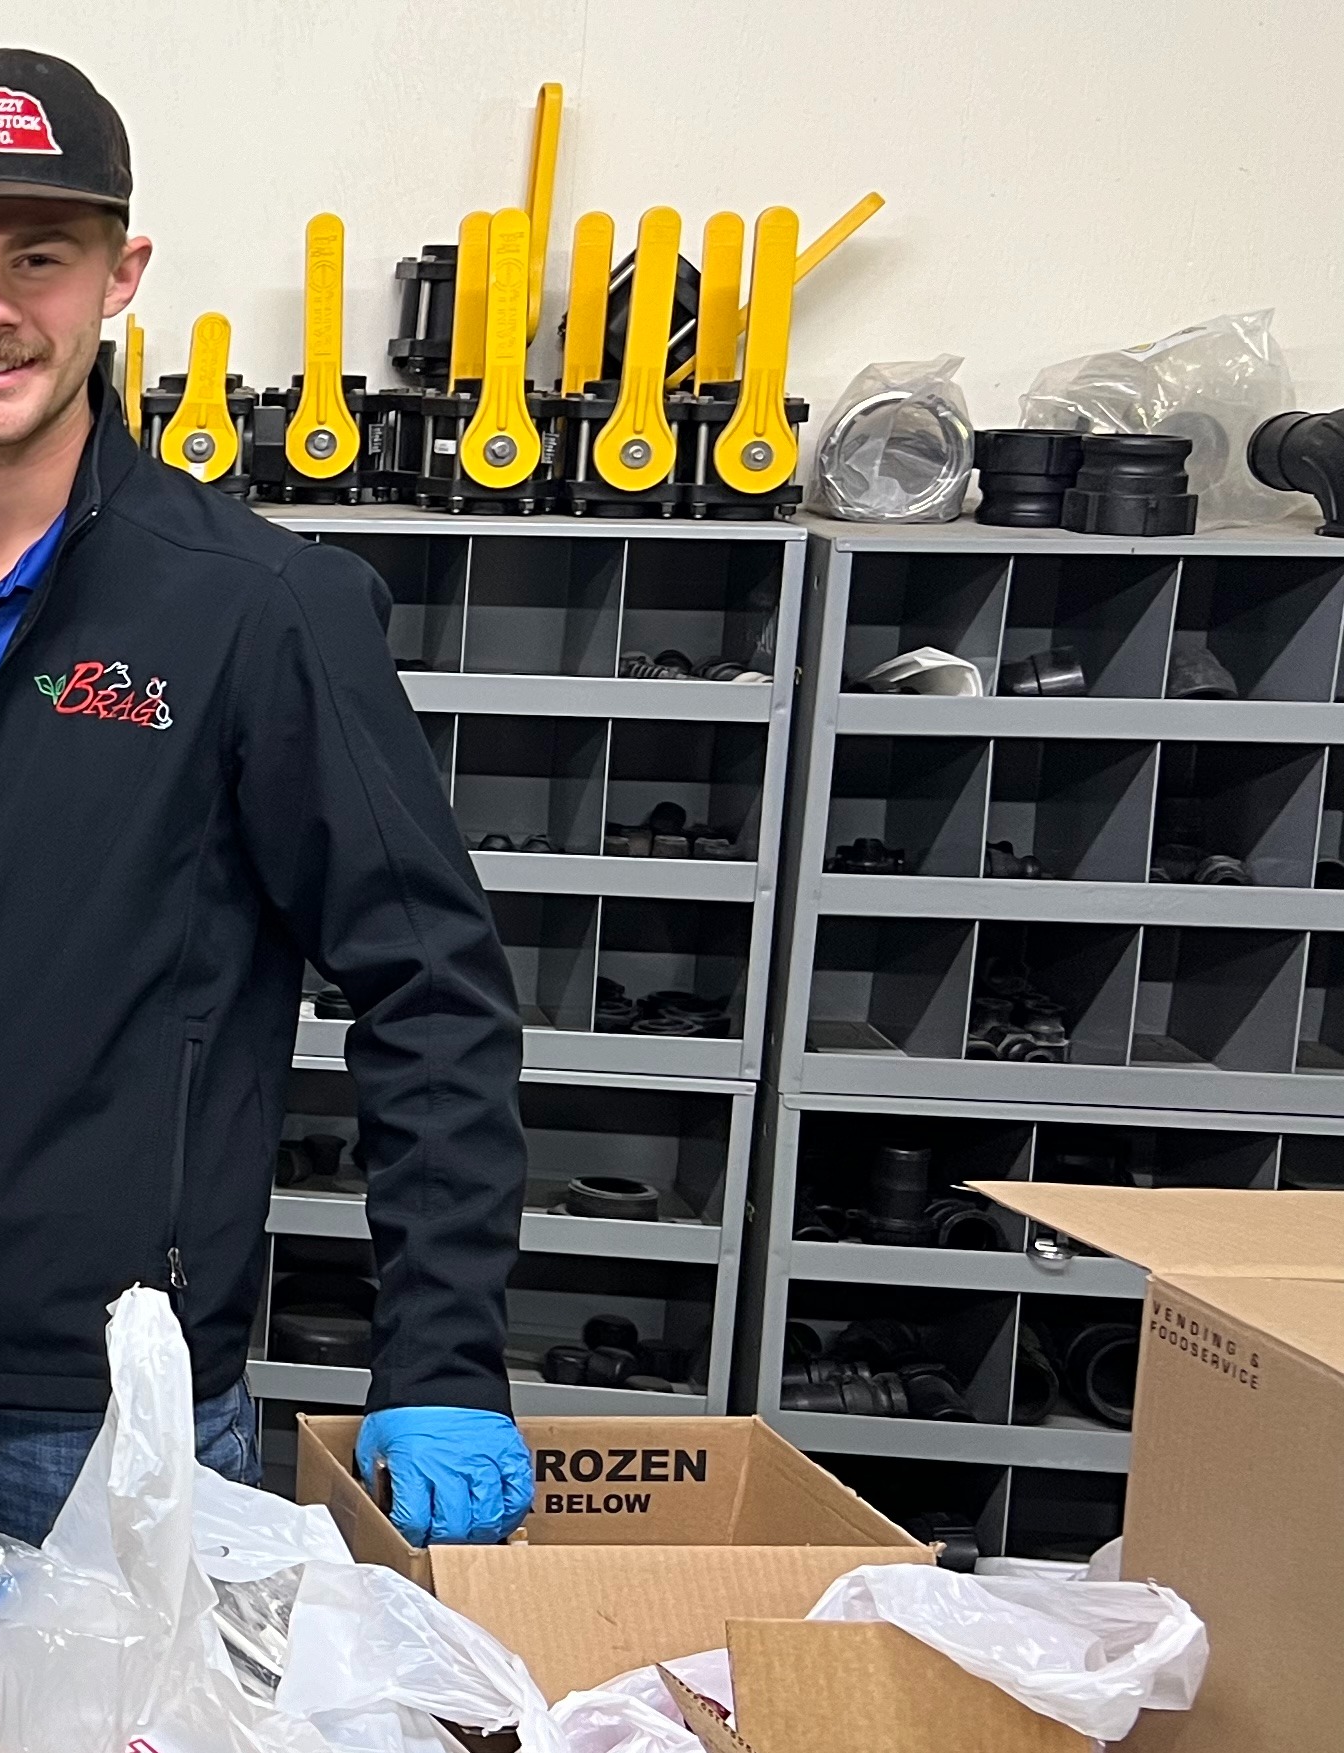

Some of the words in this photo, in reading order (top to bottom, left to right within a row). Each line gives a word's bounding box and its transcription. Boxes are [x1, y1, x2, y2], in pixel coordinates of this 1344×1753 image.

[55, 661, 158, 727] BRAG
[1150, 1319, 1259, 1391] FOODSERVICE
[1152, 1299, 1237, 1356] VENDING
[1249, 1352, 1259, 1369] &
[534, 1449, 707, 1483] ROZEN
[545, 1494, 651, 1514] BELOW
